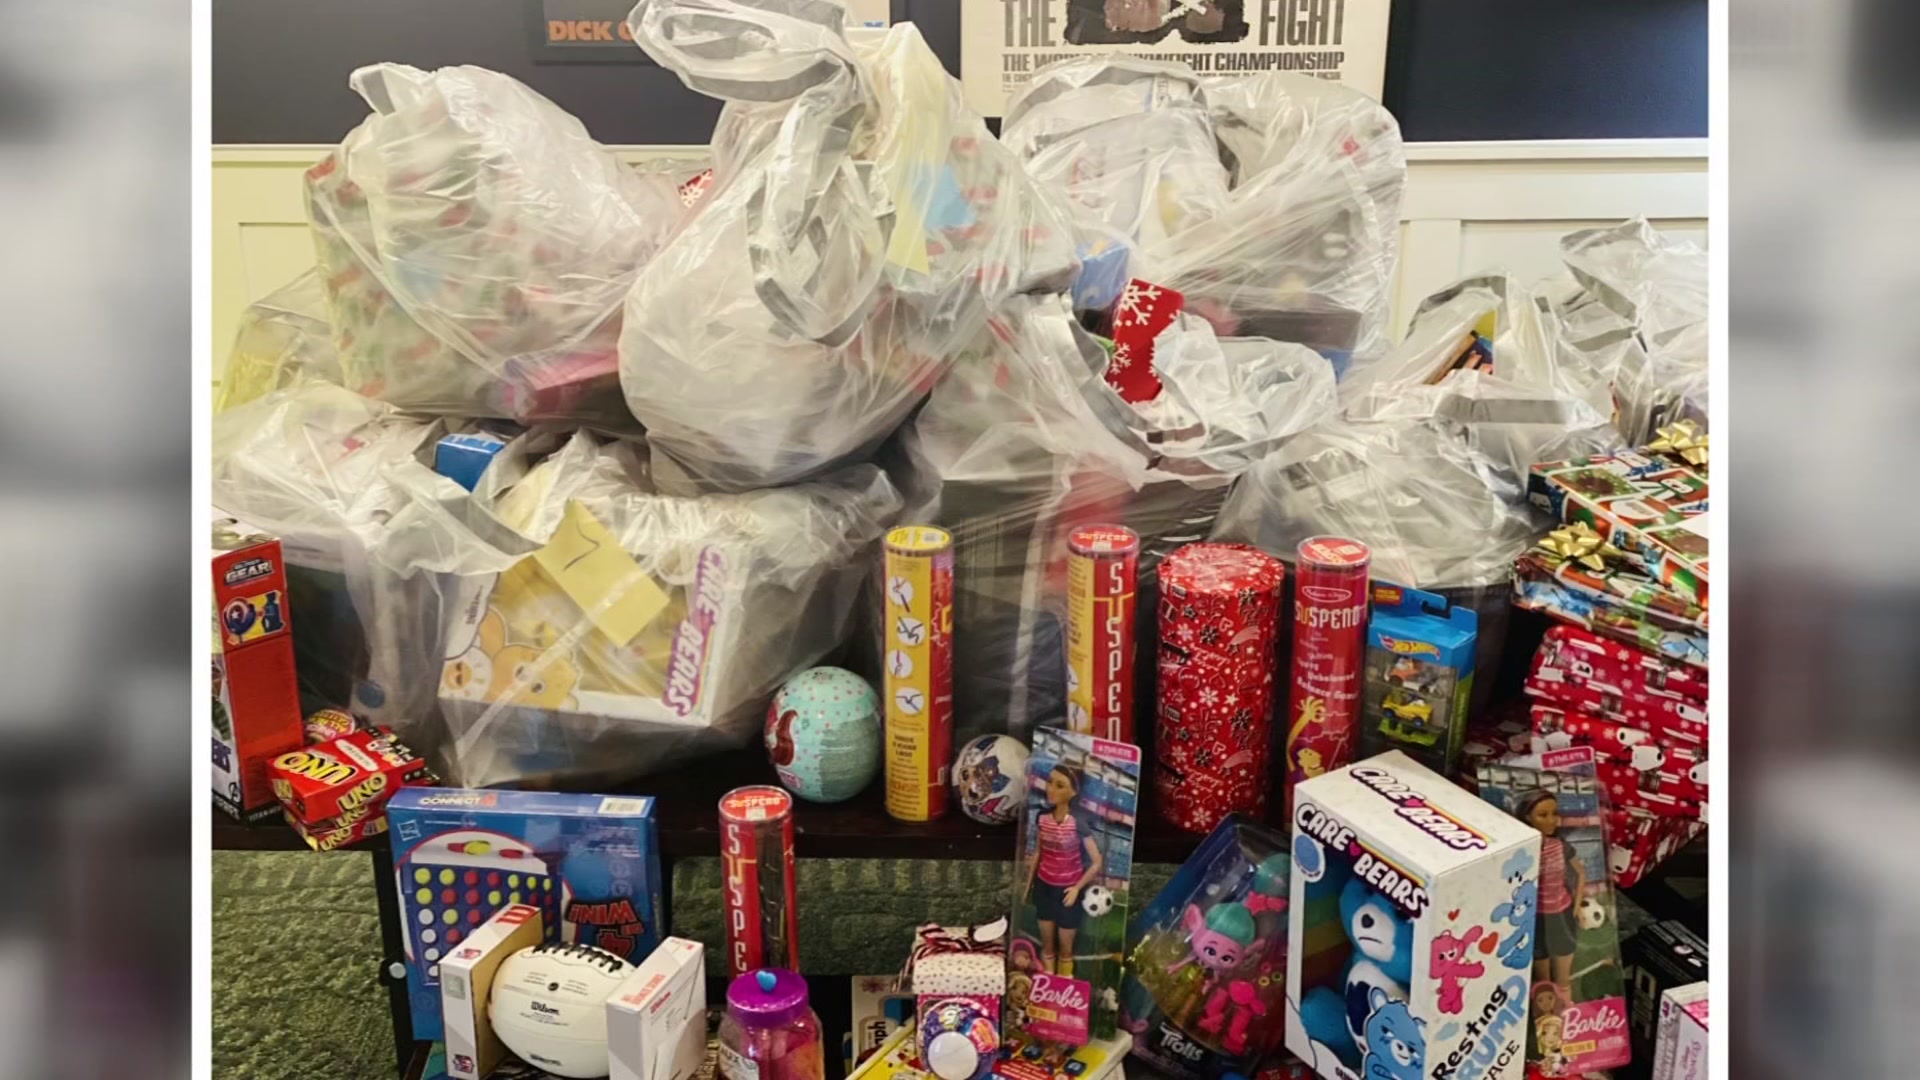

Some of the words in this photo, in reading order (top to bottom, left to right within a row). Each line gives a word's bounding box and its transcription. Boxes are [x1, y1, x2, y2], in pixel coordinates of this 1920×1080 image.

[549, 20, 613, 41] DICK
[1003, 0, 1057, 48] THE
[1258, 0, 1345, 47] FIGHT
[1002, 53, 1031, 72] THE
[1214, 52, 1345, 71] CHAMPIONSHIP
[225, 561, 271, 584] GEAR
[696, 544, 728, 625] CARE
[1295, 601, 1361, 629] SUSPEND
[665, 619, 705, 716] BEARS
[274, 751, 359, 786] UNO
[336, 772, 388, 811] UNO
[1350, 767, 1424, 802] CARE
[1395, 805, 1487, 851] BEARS
[319, 828, 353, 851] UNO
[1296, 803, 1355, 851] CARE
[1352, 851, 1430, 920] BEARS
[531, 1001, 560, 1016] Wilson
[1029, 974, 1089, 1010] Barbie
[1159, 1021, 1204, 1062] Trolls
[1431, 983, 1508, 1080] Resting
[1457, 974, 1527, 1080] RUMP
[1561, 1005, 1626, 1040] Barbie
[1482, 1039, 1520, 1080] ACE
